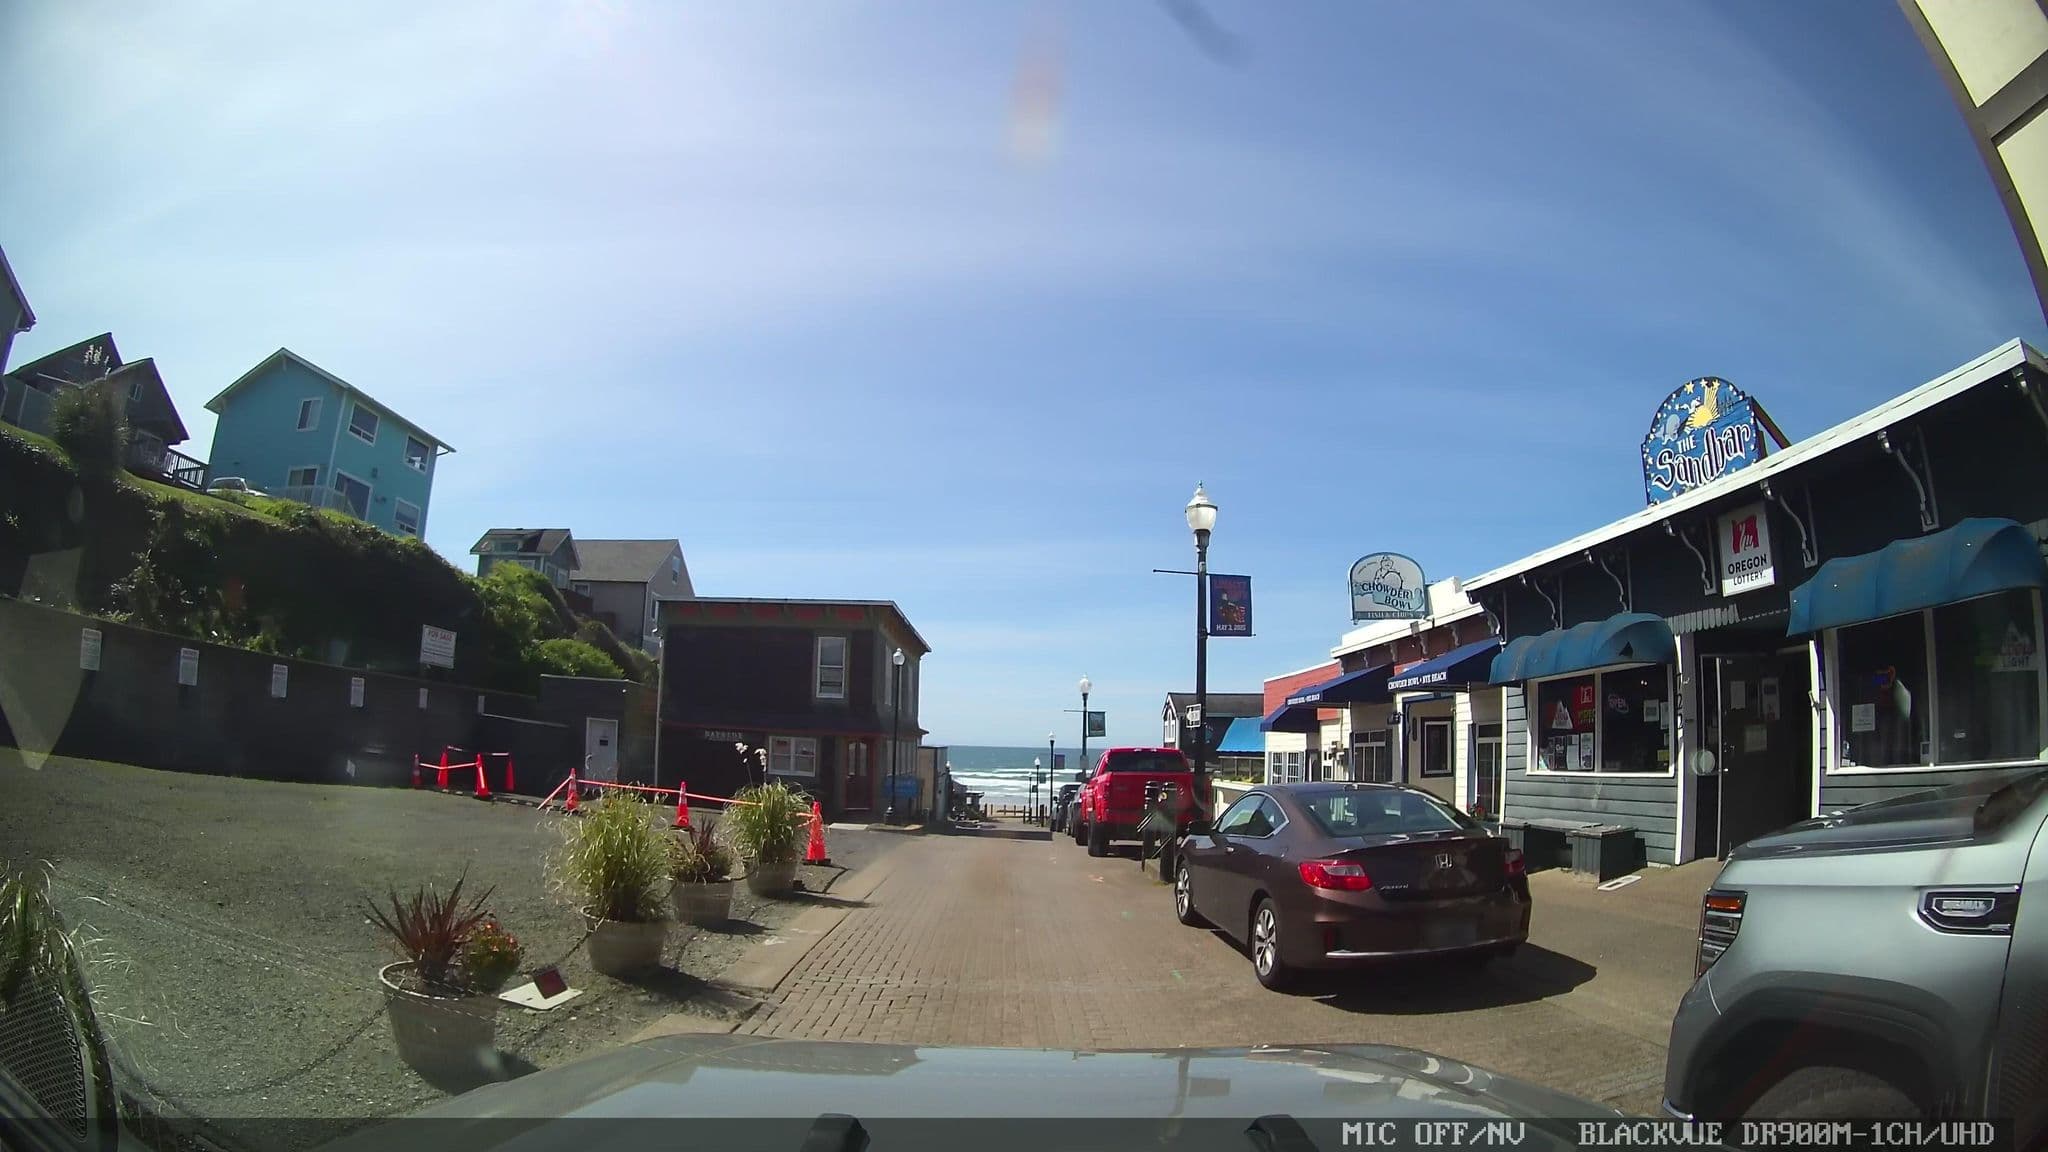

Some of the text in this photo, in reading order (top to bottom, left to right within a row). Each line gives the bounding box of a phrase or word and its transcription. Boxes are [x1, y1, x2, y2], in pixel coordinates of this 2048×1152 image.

[1677, 435, 1697, 453] THE
[1652, 424, 1751, 490] Sandbar
[1727, 554, 1768, 575] OREGON
[1733, 569, 1764, 586] LOTTERY
[1361, 582, 1411, 599] CHOWDER
[1384, 596, 1413, 610] BOWL
[1387, 679, 1407, 690] CHOWDER
[1431, 671, 1447, 682] BEACH
